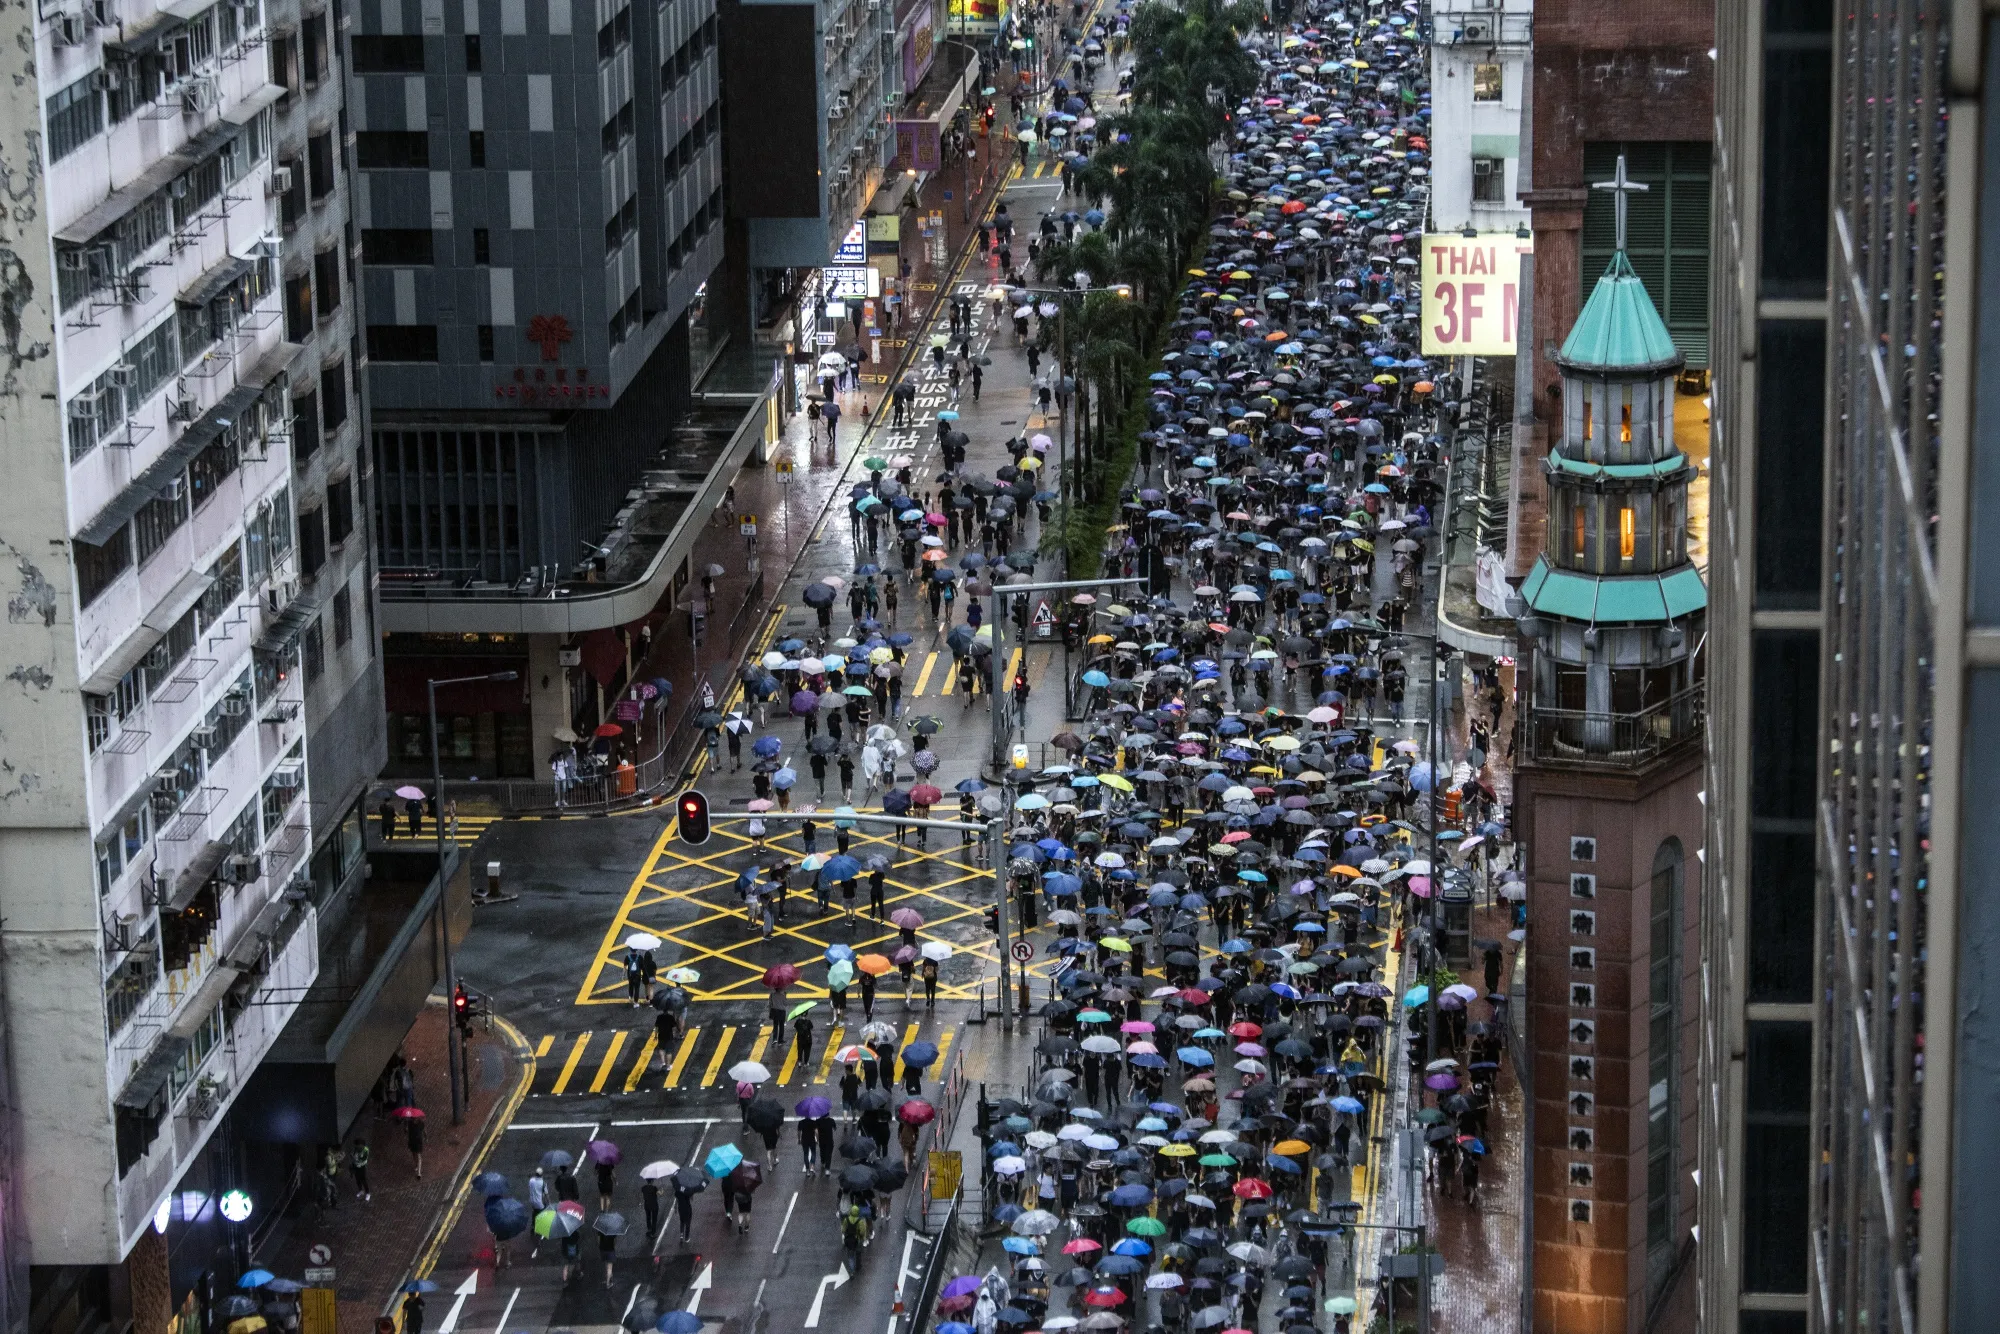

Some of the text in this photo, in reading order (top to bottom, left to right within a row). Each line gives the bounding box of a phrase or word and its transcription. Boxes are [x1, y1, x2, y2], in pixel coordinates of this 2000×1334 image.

[1430, 246, 1496, 275] THAI
[1434, 281, 1485, 344] 3F
[907, 396, 947, 408] TOP
[881, 430, 920, 450] 站
